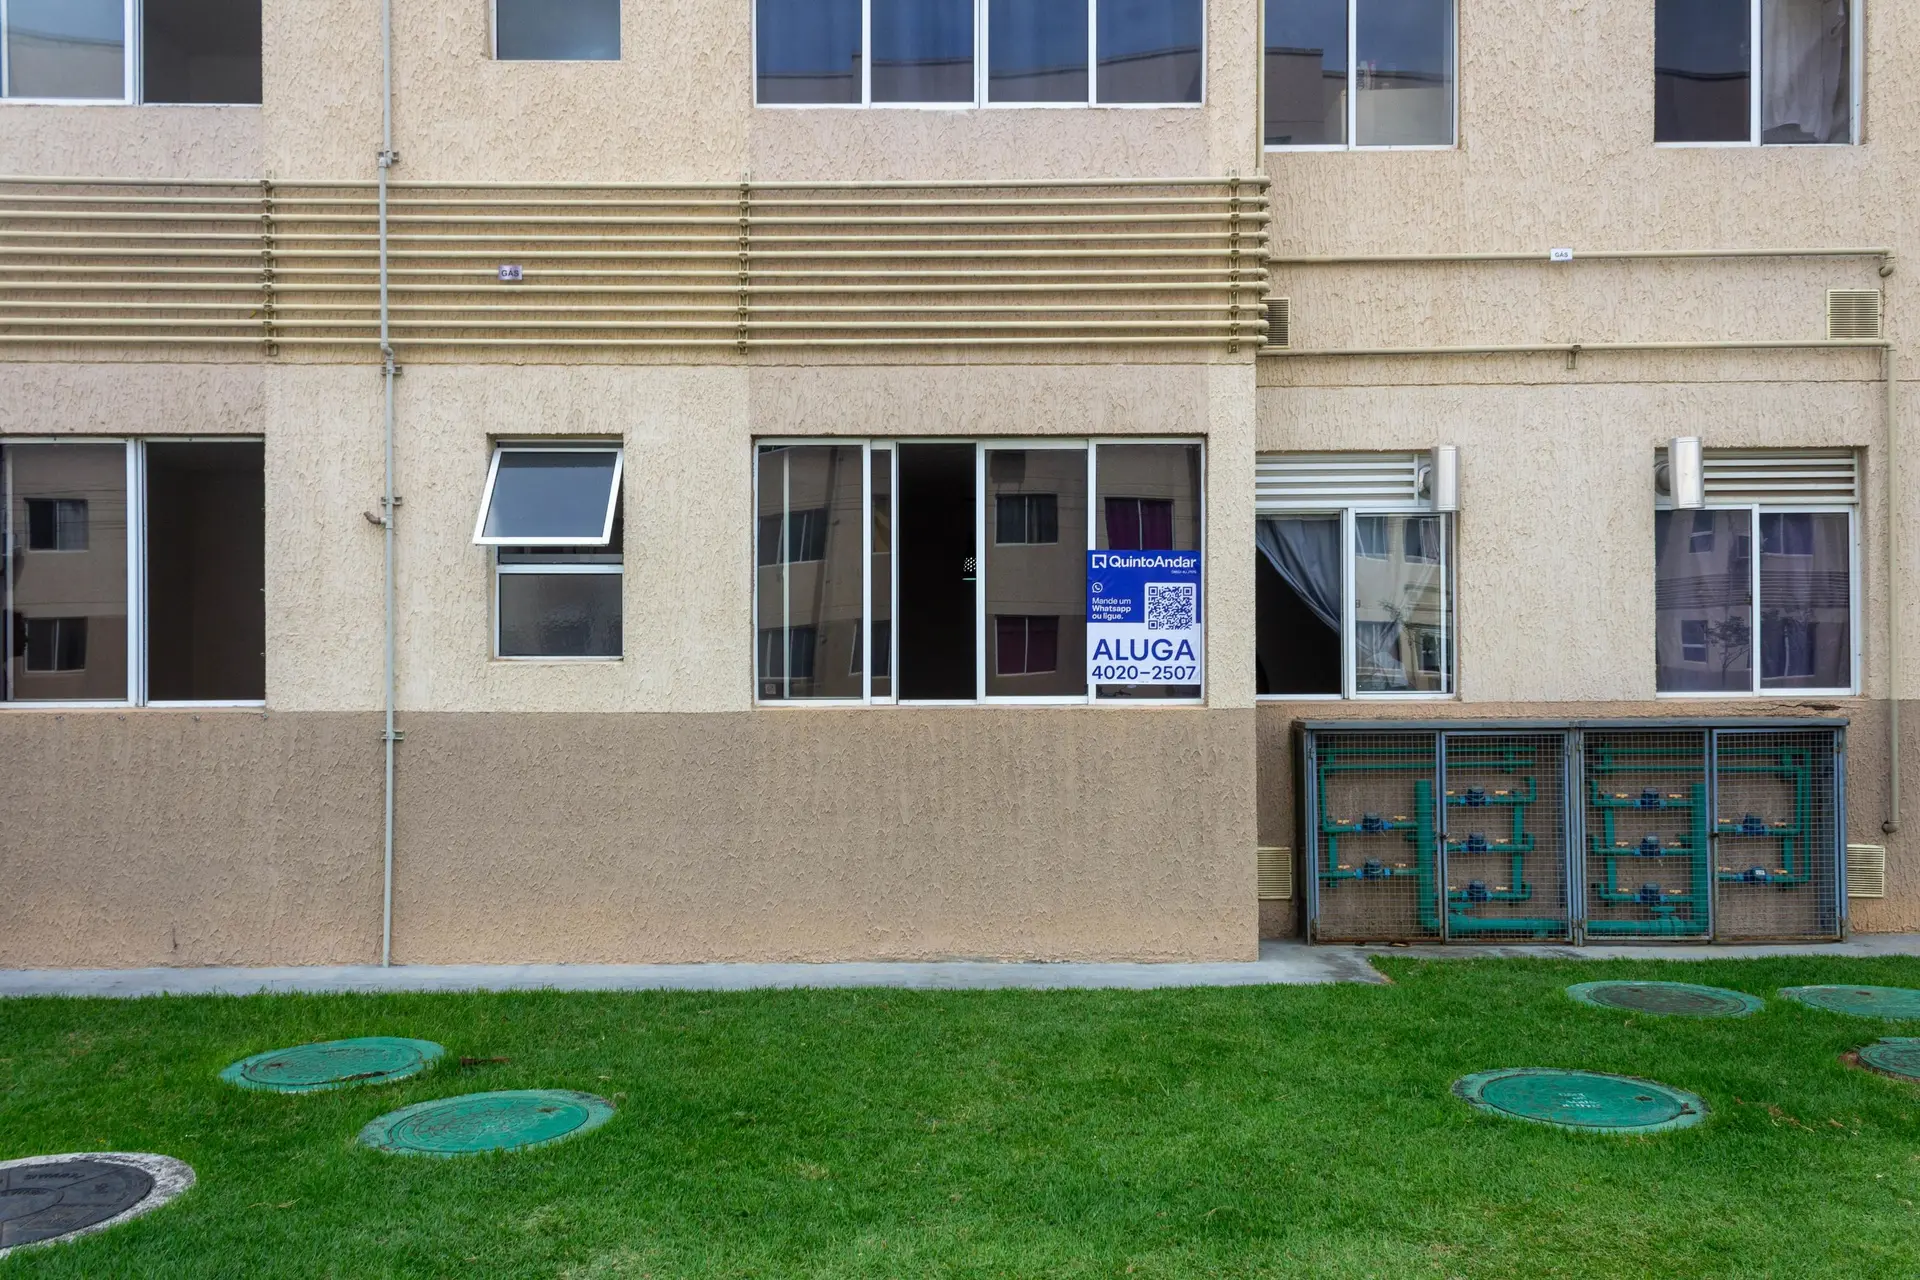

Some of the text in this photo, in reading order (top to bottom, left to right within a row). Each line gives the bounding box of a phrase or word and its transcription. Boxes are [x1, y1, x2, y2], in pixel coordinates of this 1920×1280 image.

[1109, 555, 1197, 568] QuintoAndar
[1092, 597, 1118, 605] Mande
[1092, 605, 1132, 613] Whatsapp
[1102, 612, 1124, 621] ligue.
[1092, 638, 1196, 662] ALUGA
[1092, 665, 1196, 680] 4020-2507
